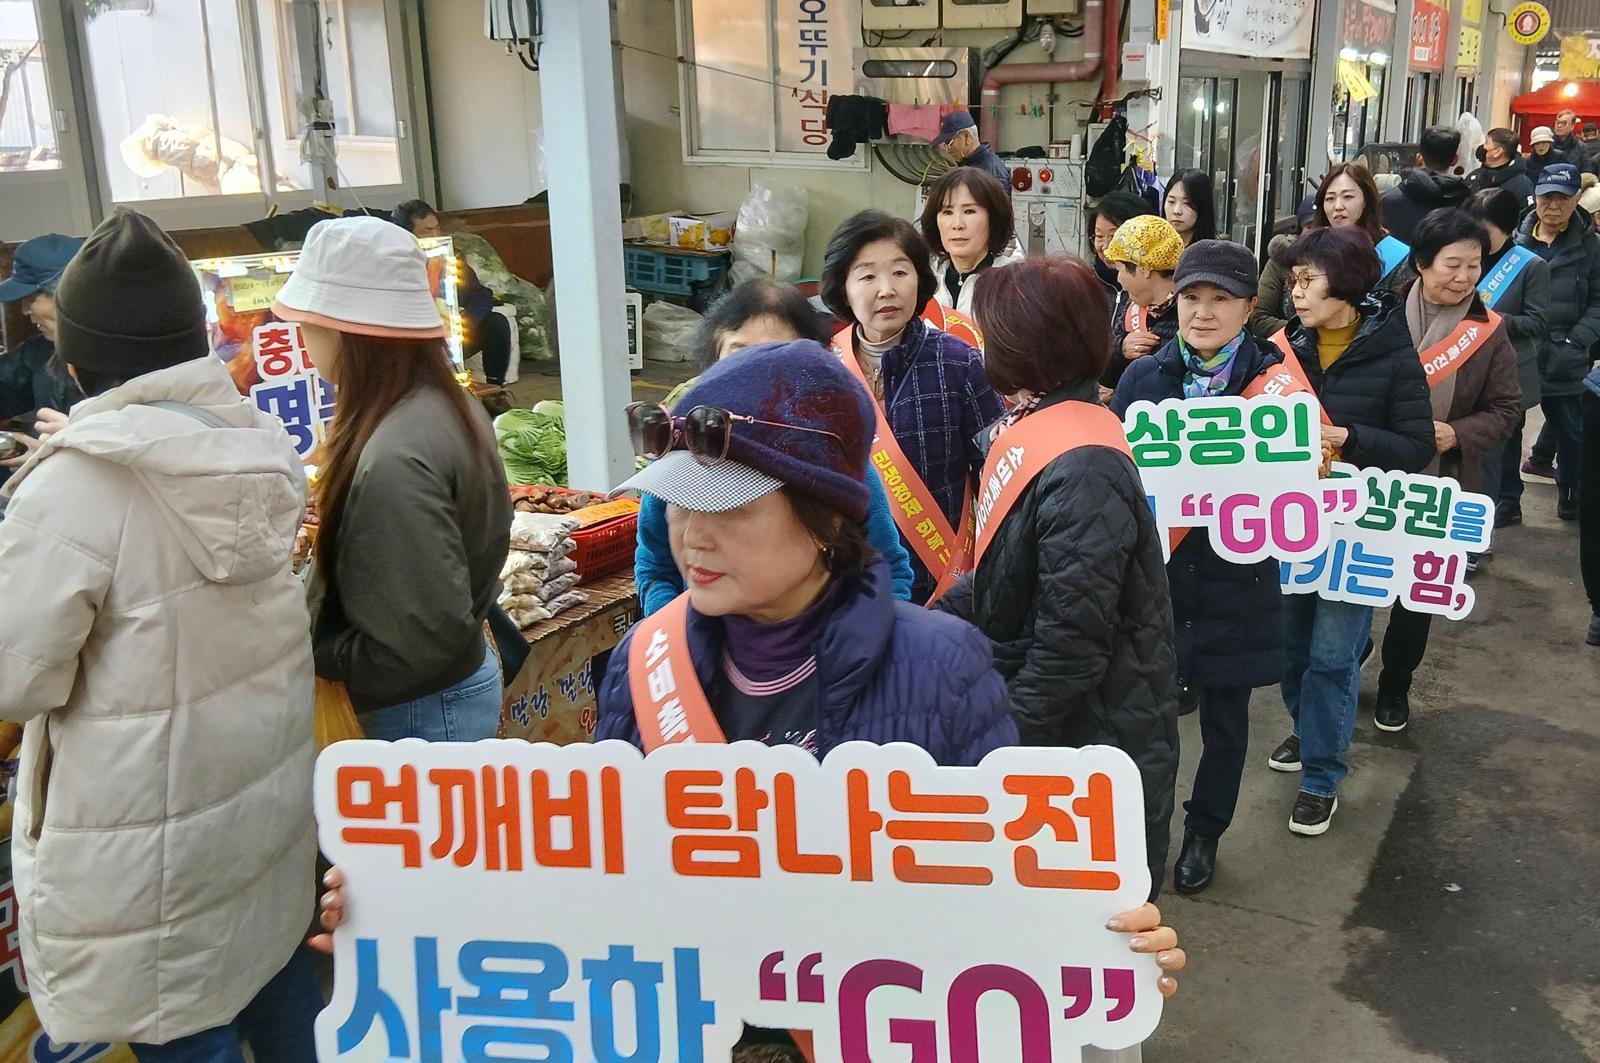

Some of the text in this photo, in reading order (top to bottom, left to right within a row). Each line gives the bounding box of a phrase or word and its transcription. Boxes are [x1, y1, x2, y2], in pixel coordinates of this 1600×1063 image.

[1126, 402, 1312, 468] 상공인
[1409, 550, 1467, 611] 힘,
[336, 763, 1121, 891] 먹깨비 탐나는전
